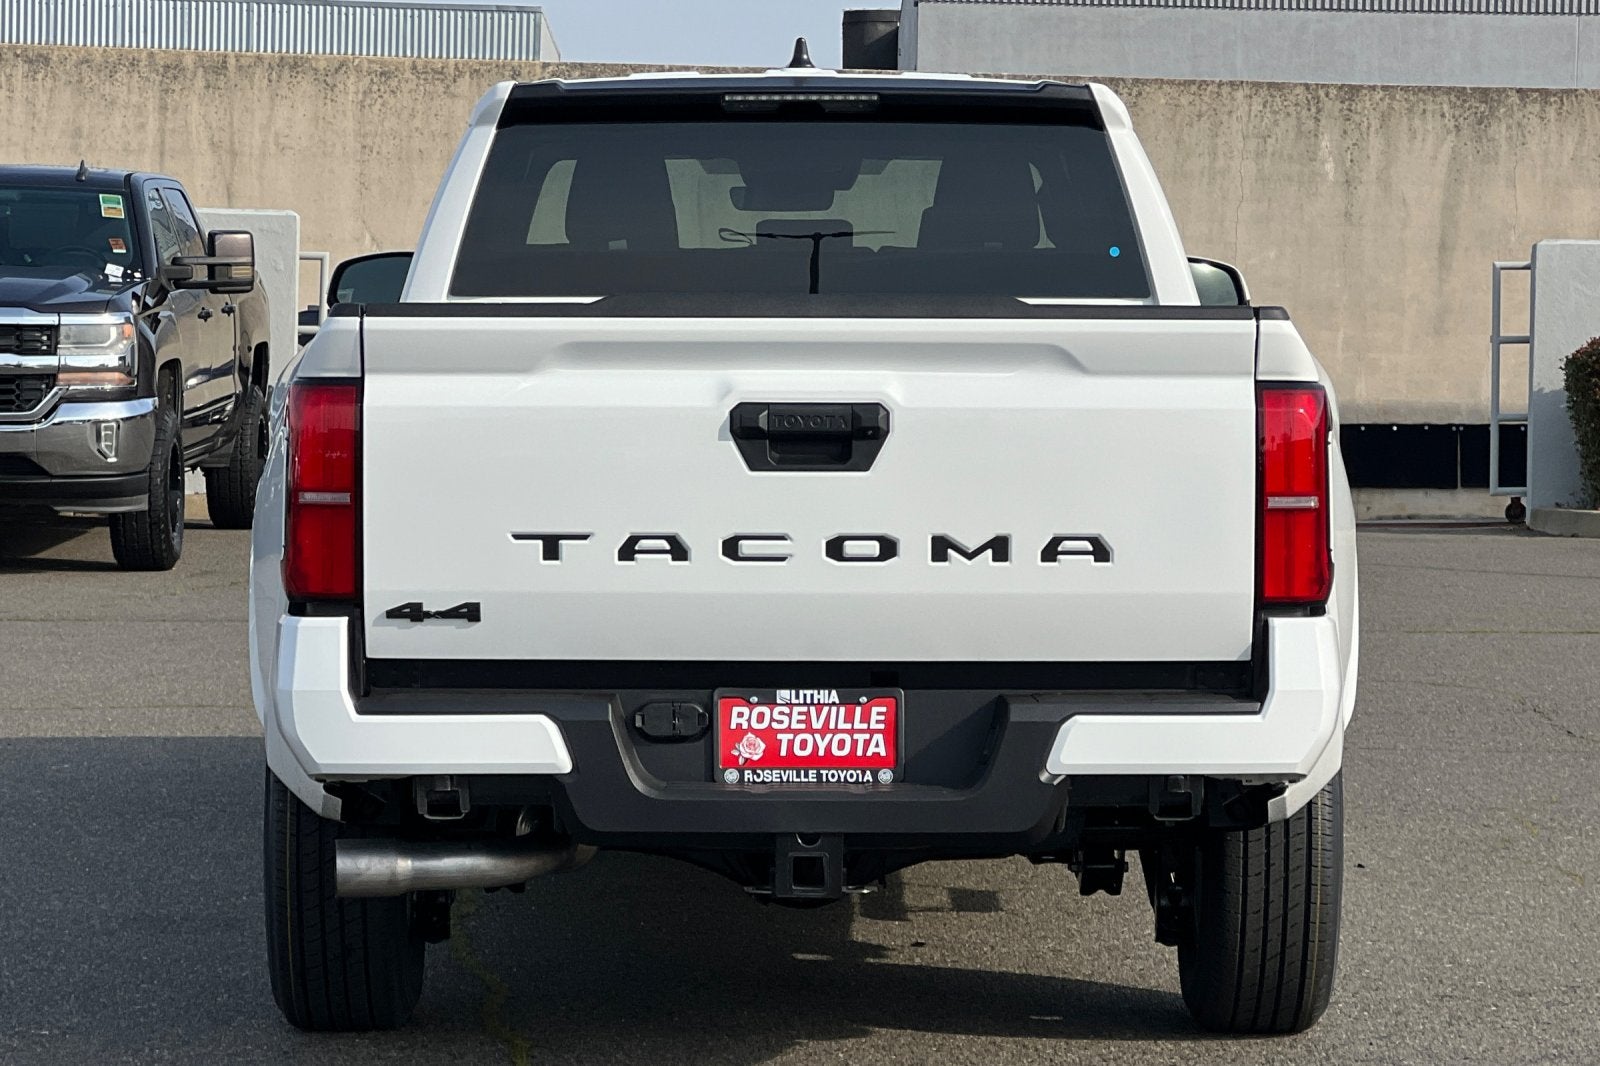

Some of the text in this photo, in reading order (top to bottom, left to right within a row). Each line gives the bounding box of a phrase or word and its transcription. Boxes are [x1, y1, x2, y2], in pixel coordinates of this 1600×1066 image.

[772, 414, 849, 429] TOYOTA
[509, 532, 1112, 564] TACOMA
[790, 689, 840, 704] LITHIA
[729, 705, 888, 730] ROSEVILLE
[776, 732, 887, 757] TOYOTA
[744, 769, 873, 783] ROSEVILLE TOYOTA
